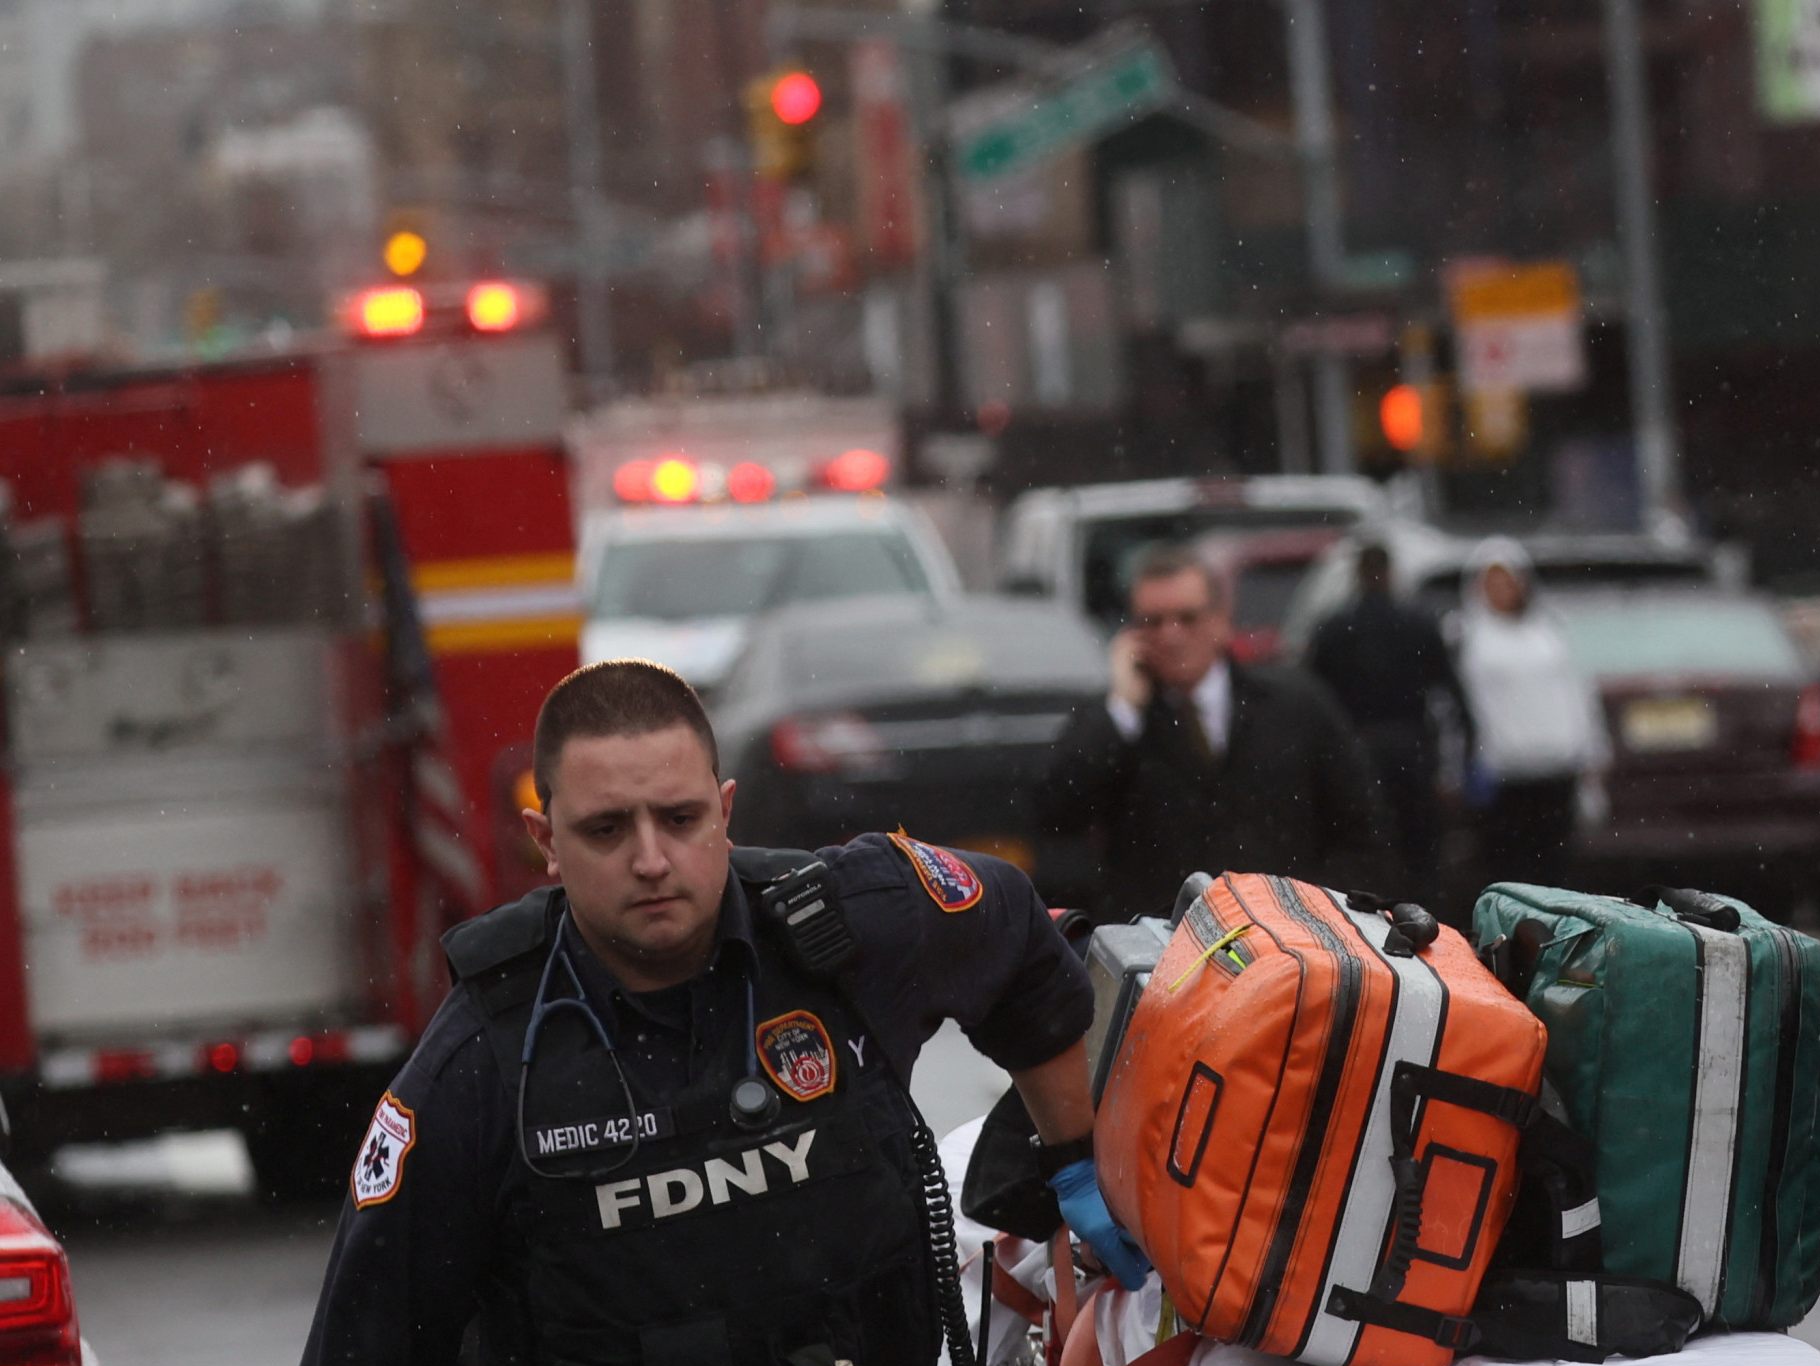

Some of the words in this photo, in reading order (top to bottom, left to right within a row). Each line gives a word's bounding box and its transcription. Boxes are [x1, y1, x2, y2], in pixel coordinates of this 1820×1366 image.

[536, 1122, 600, 1155] MEDIC
[372, 1176, 392, 1194] YORK
[595, 1129, 817, 1230] FDNY
